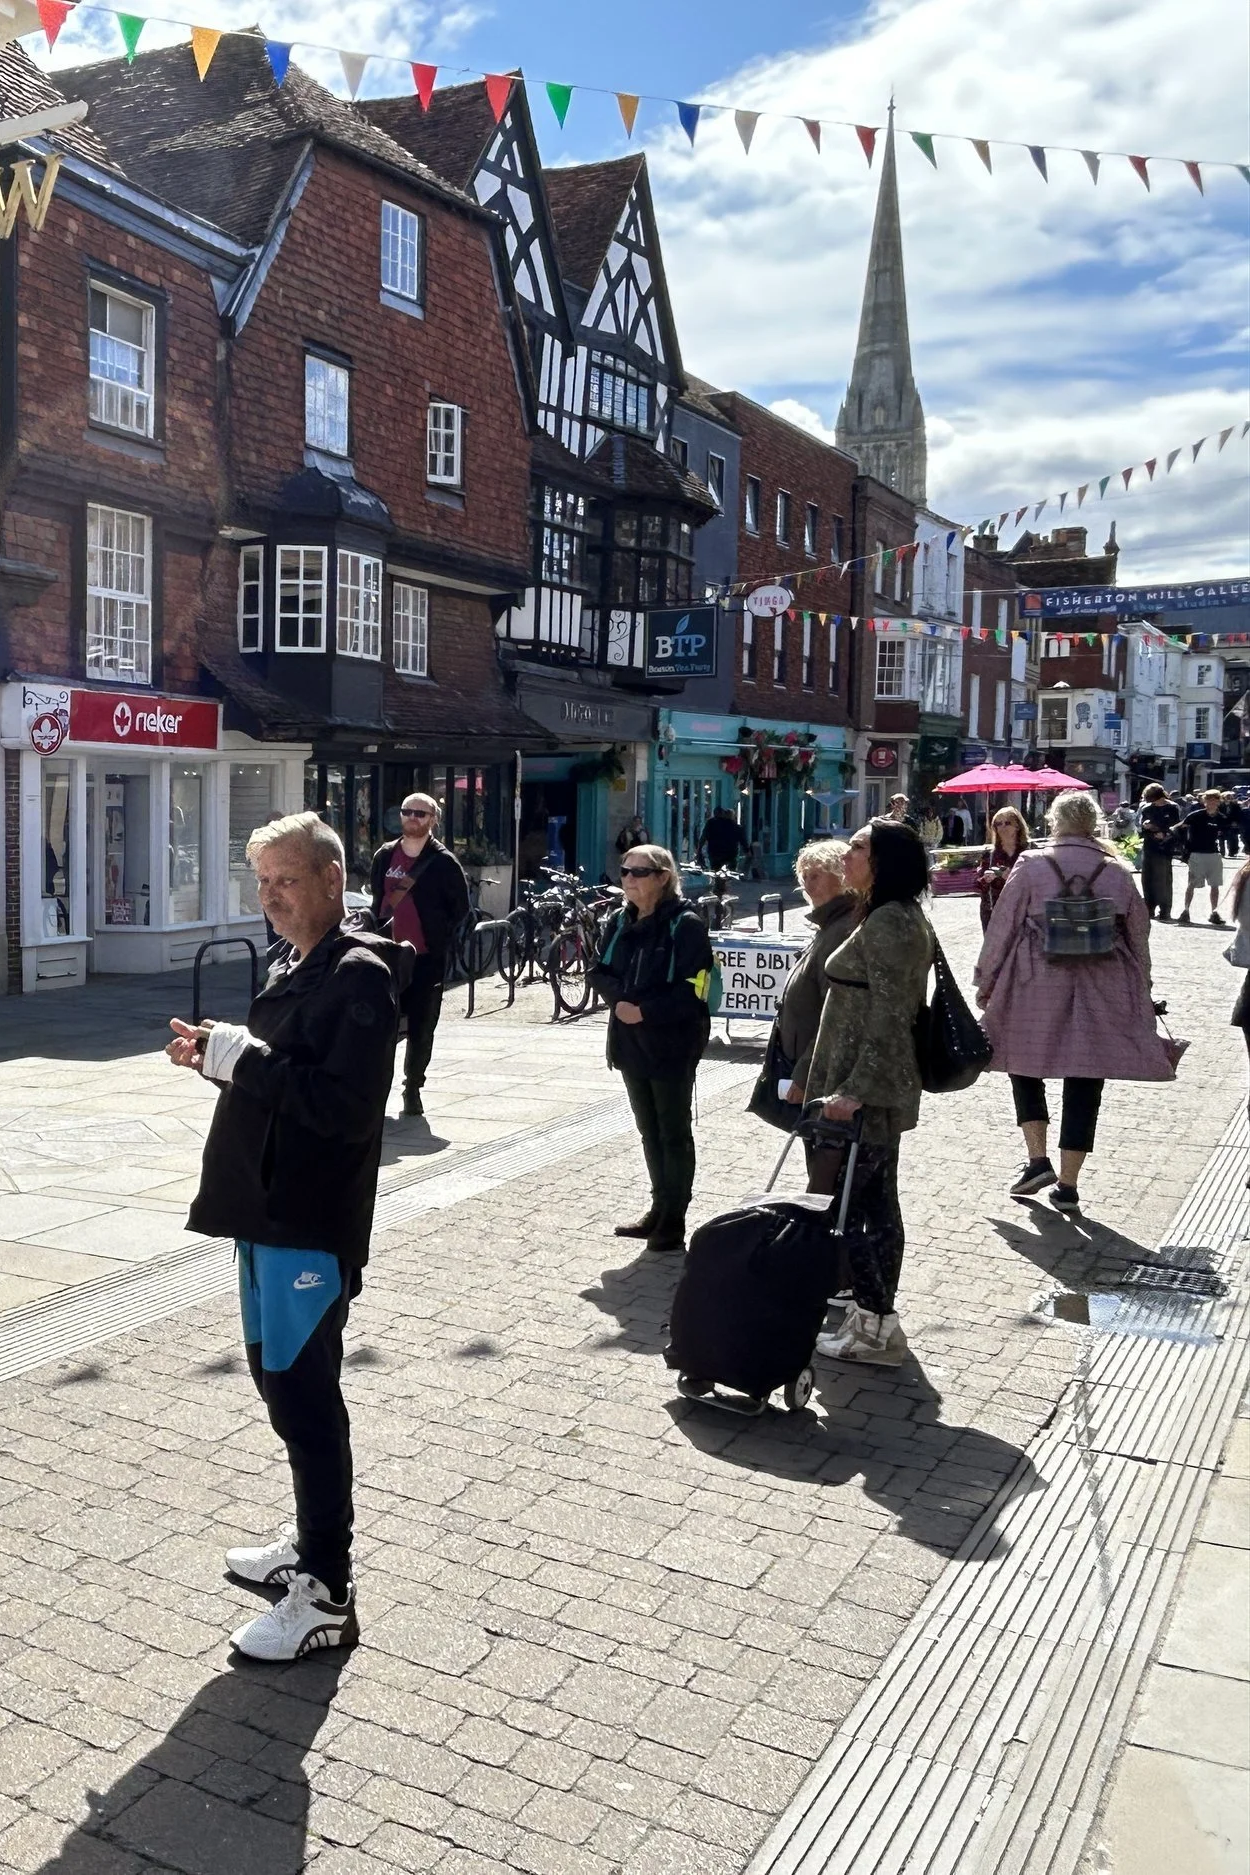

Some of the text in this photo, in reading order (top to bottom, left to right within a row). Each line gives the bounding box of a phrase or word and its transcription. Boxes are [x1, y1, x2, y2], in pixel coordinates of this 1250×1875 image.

[1046, 593, 1137, 606] FISHERTON
[1147, 590, 1185, 600] MILL
[655, 634, 707, 659] BTP
[135, 706, 182, 733] rieker
[716, 951, 791, 971] REE BIBL
[732, 973, 776, 989] AND
